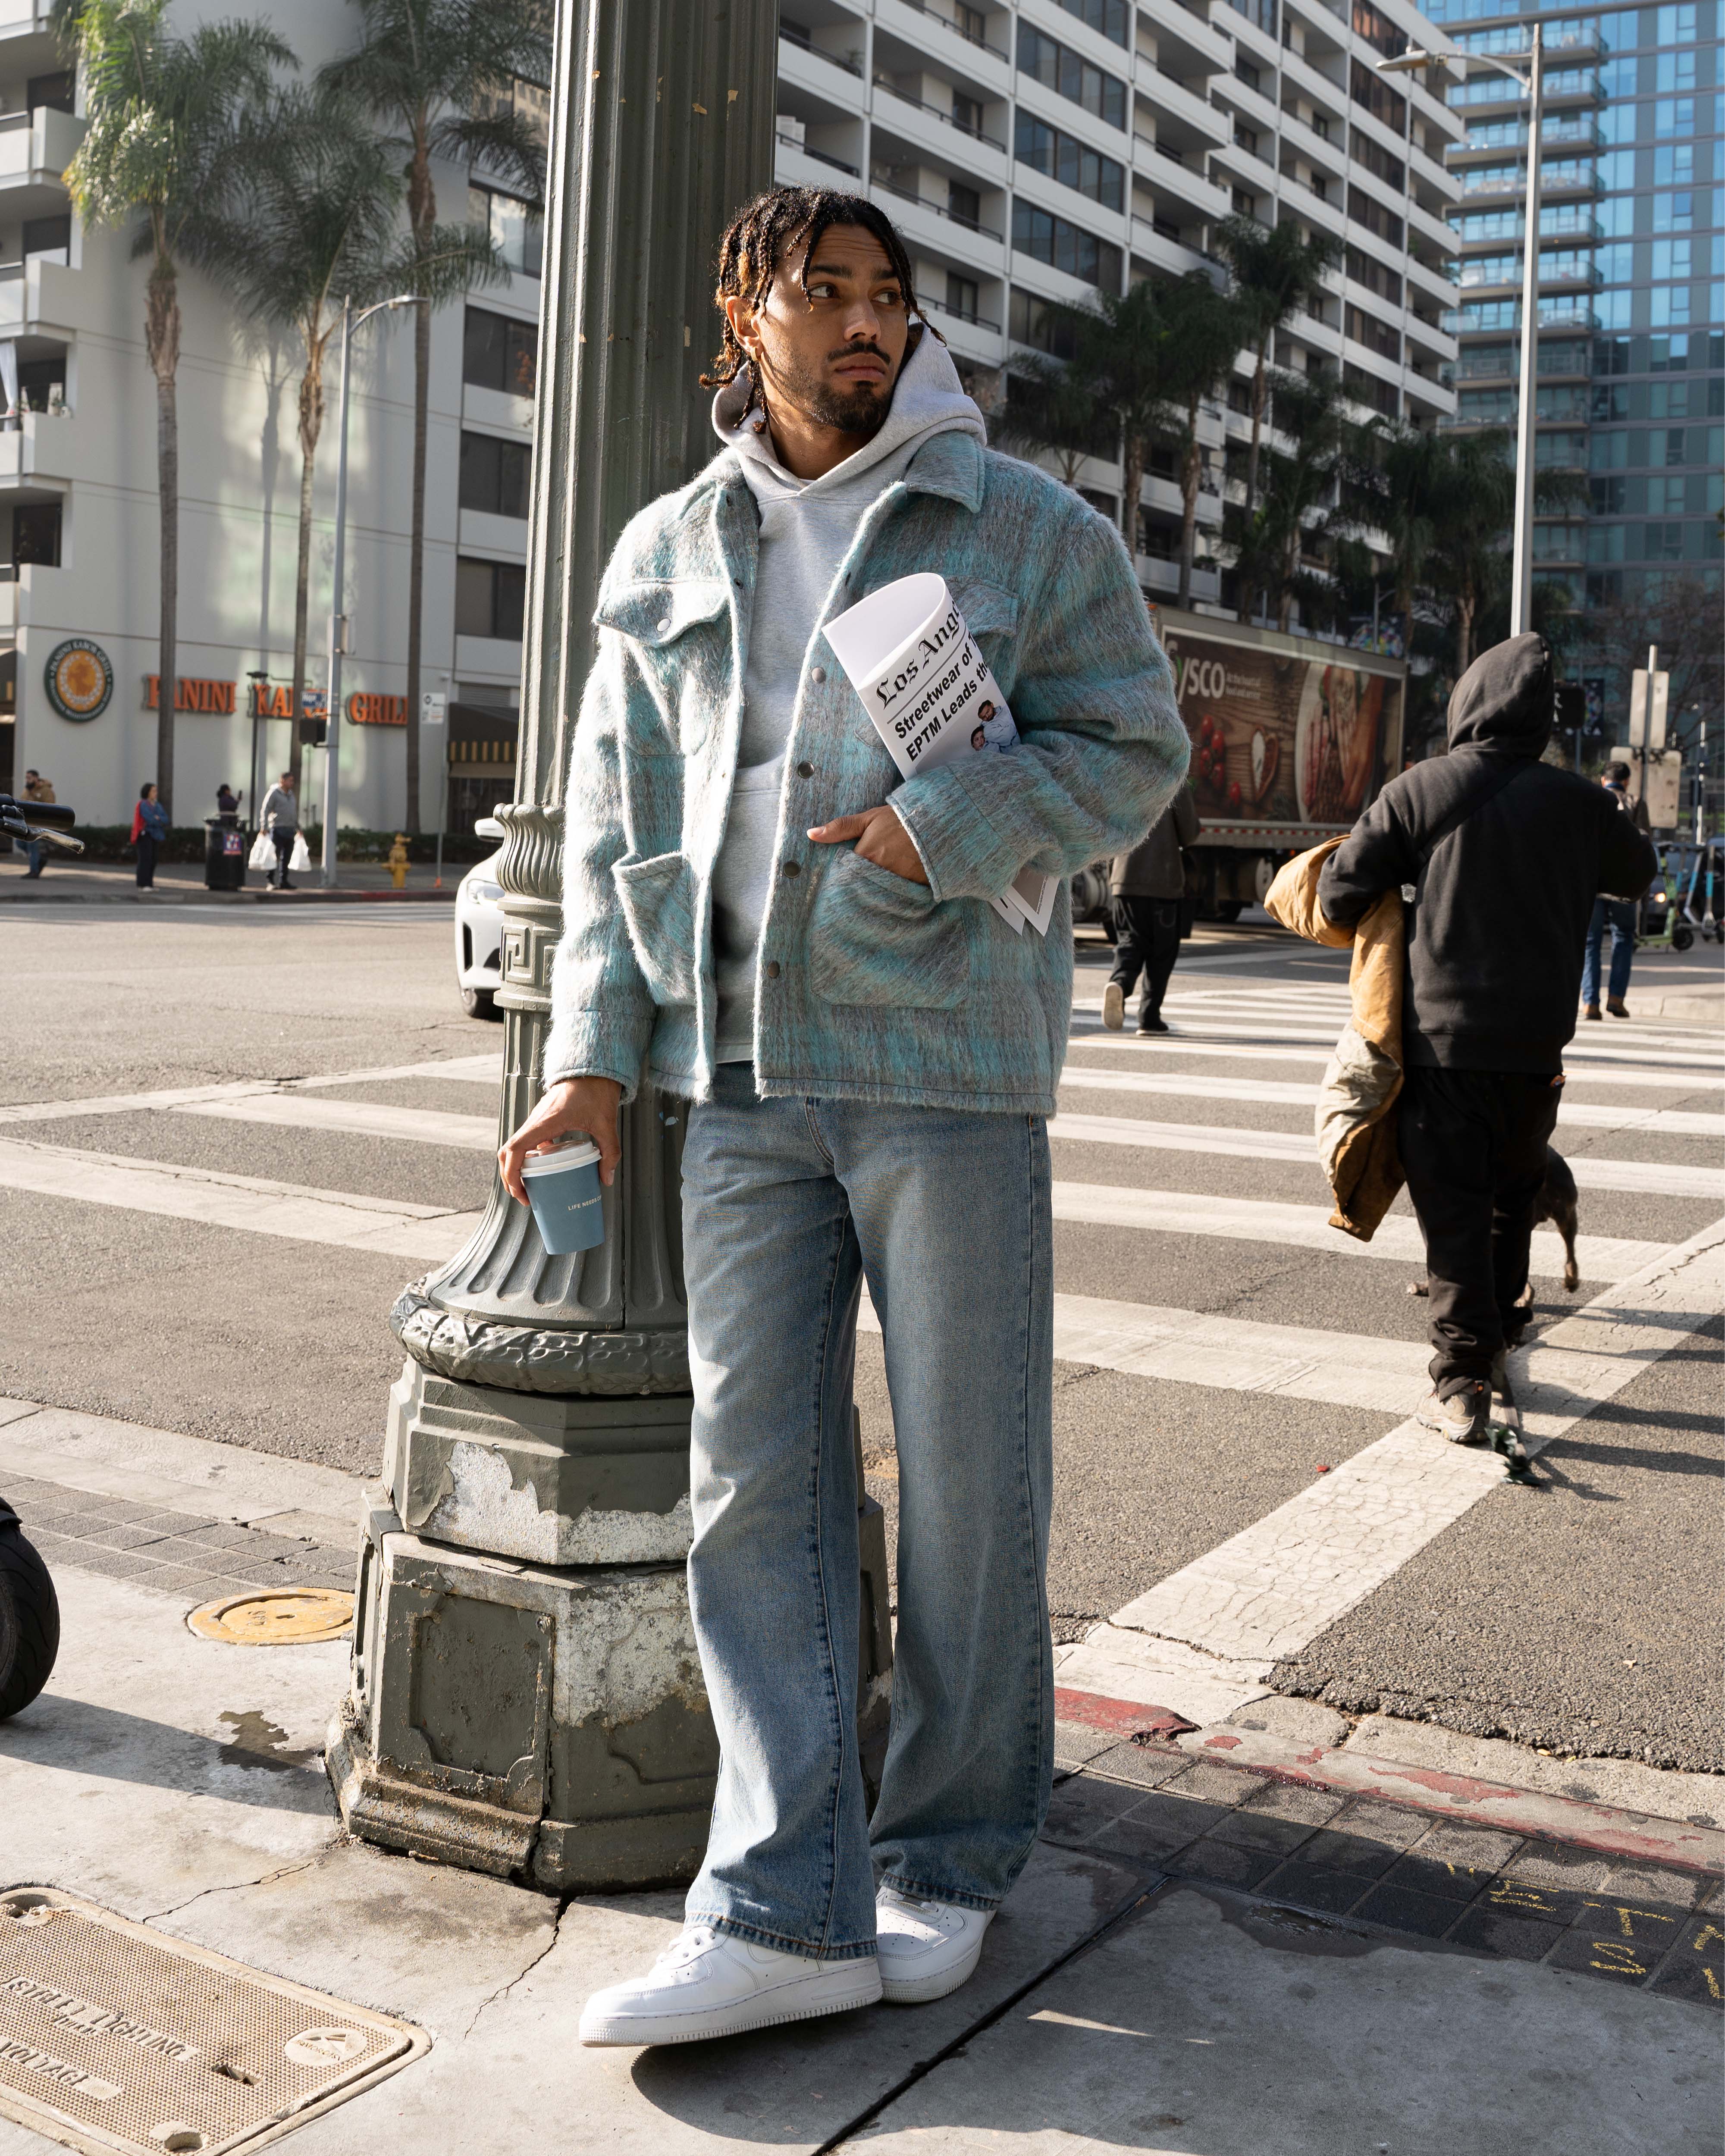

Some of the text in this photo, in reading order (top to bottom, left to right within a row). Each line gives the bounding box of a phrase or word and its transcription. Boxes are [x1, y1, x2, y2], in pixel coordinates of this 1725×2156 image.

[876, 659, 919, 710] Los
[895, 662, 961, 739] Streetwear
[962, 642, 972, 666] of
[906, 716, 942, 762] EPTM
[941, 680, 977, 723] Leads
[582, 1197, 597, 1207] NEEDS
[90, 2011, 186, 2056] LIGHTING
